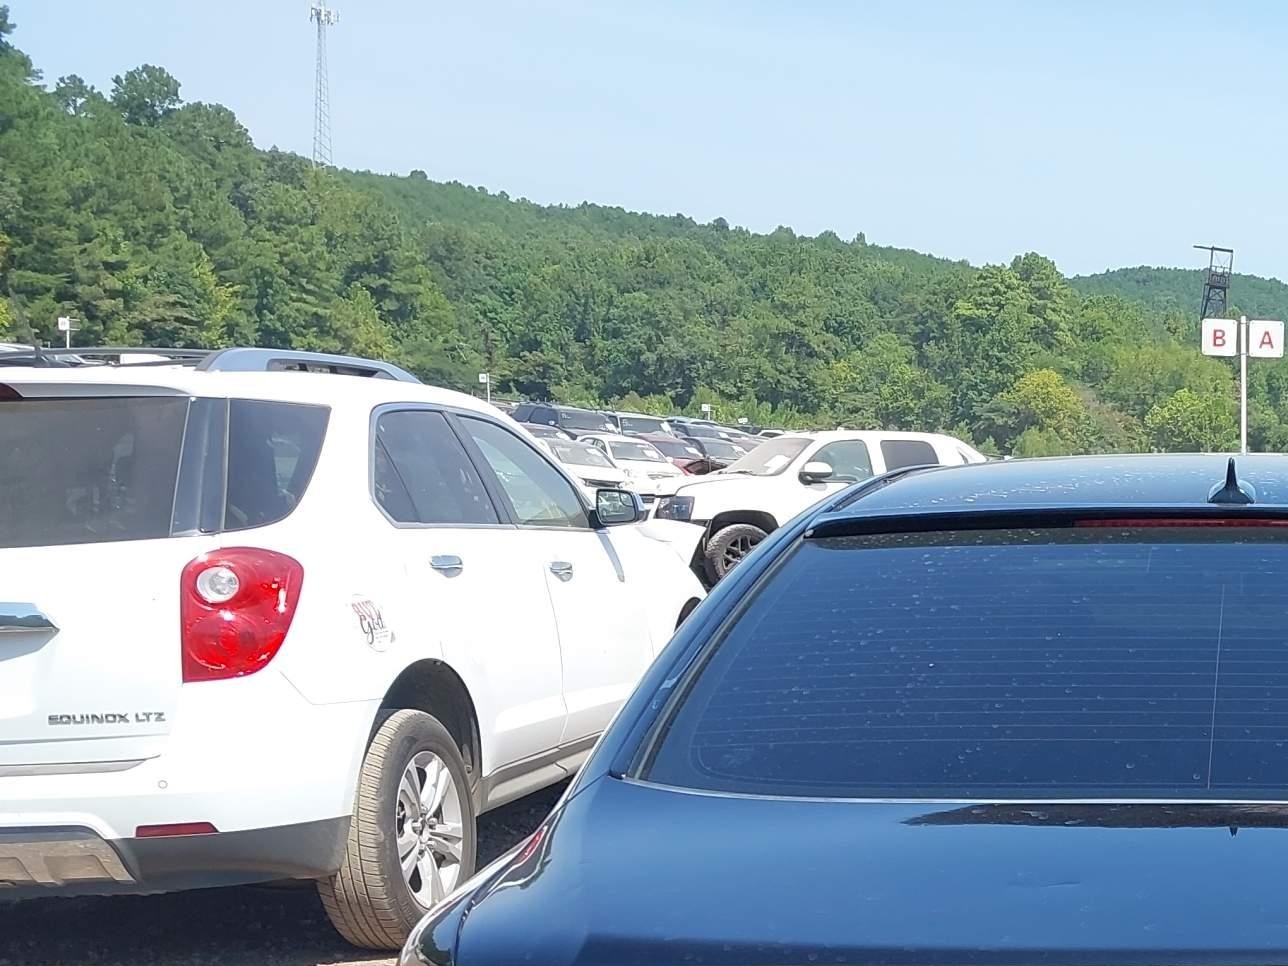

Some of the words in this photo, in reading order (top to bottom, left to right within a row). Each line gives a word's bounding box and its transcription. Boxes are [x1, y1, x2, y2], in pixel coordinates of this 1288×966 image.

[1212, 329, 1226, 347] B
[1258, 331, 1275, 349] A
[48, 712, 130, 726] EQUINOX
[135, 712, 166, 723] LTZ
